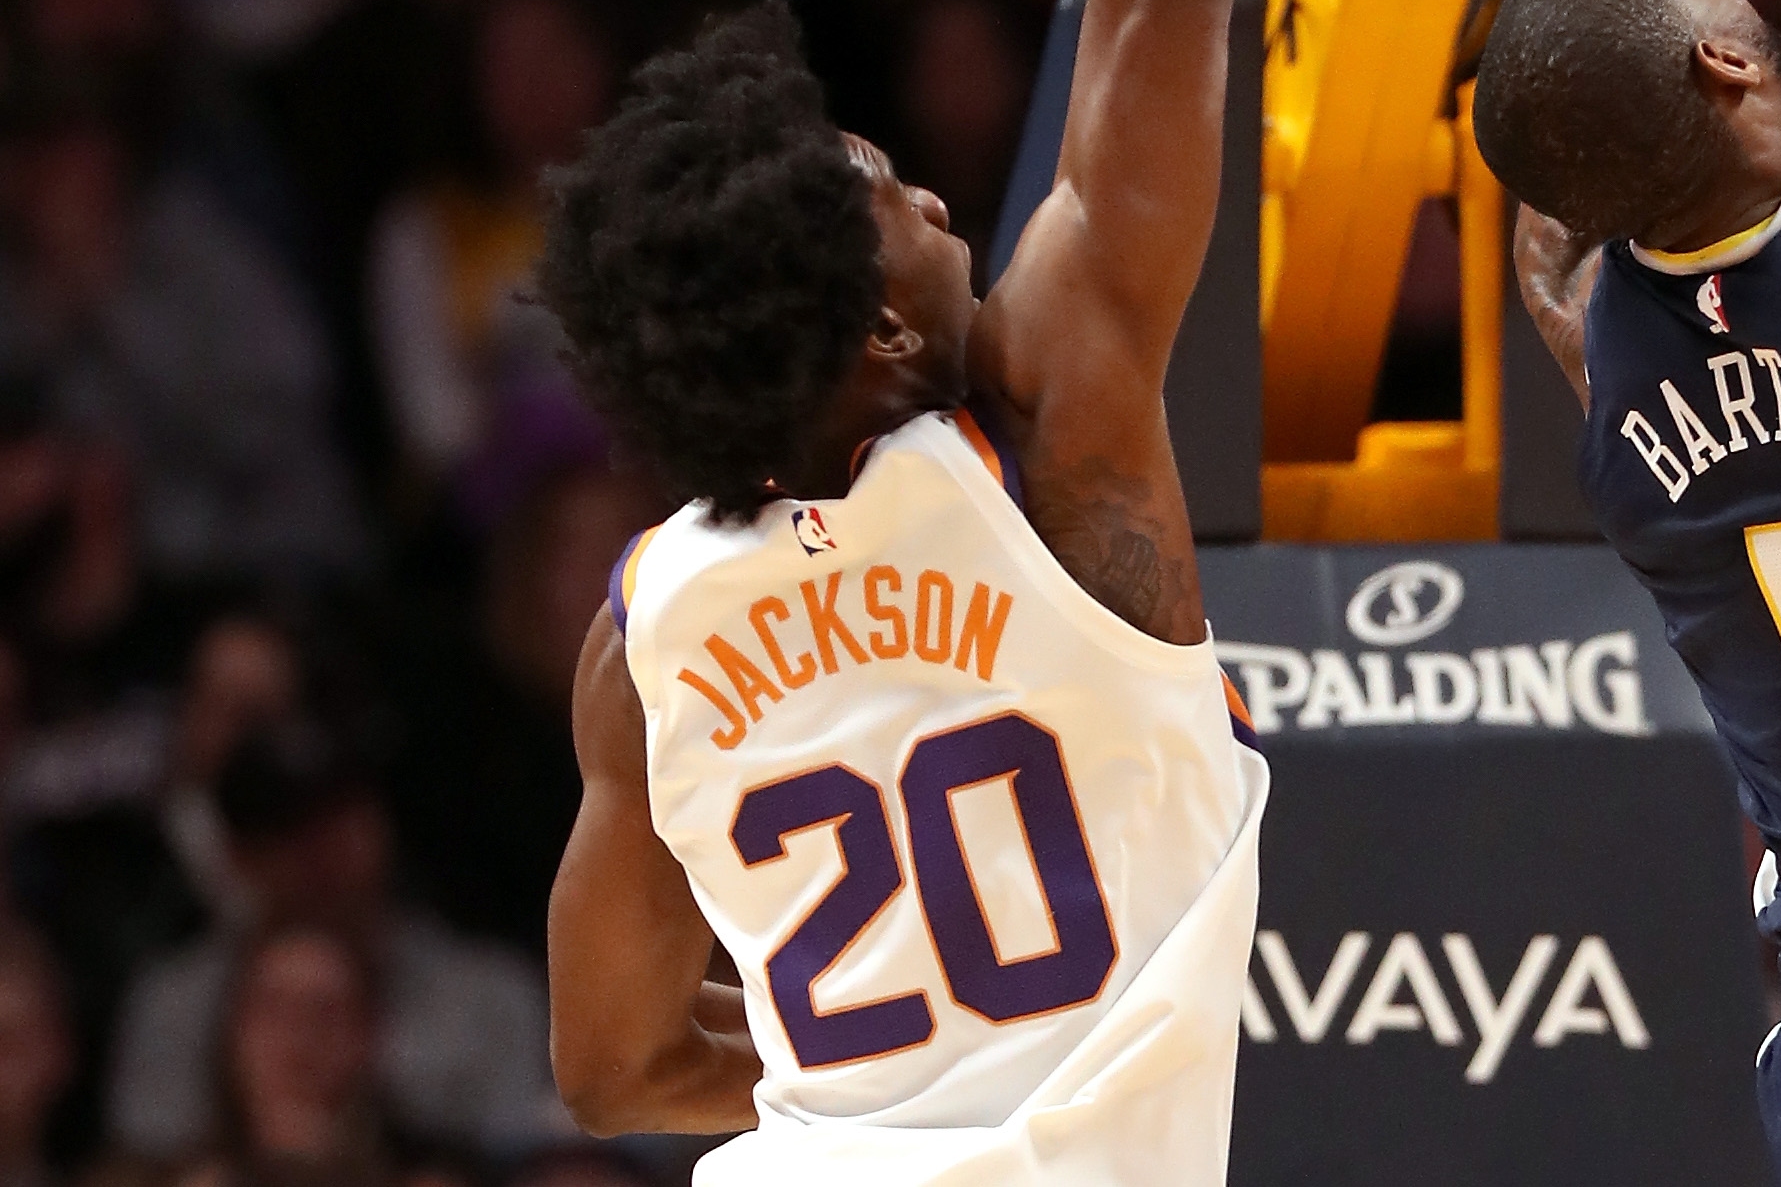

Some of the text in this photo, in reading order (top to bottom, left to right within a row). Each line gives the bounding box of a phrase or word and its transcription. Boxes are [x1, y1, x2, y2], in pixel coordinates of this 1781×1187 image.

[677, 565, 1013, 750] JACKSON
[1215, 631, 1656, 736] PALDING
[728, 709, 1120, 1072] 20
